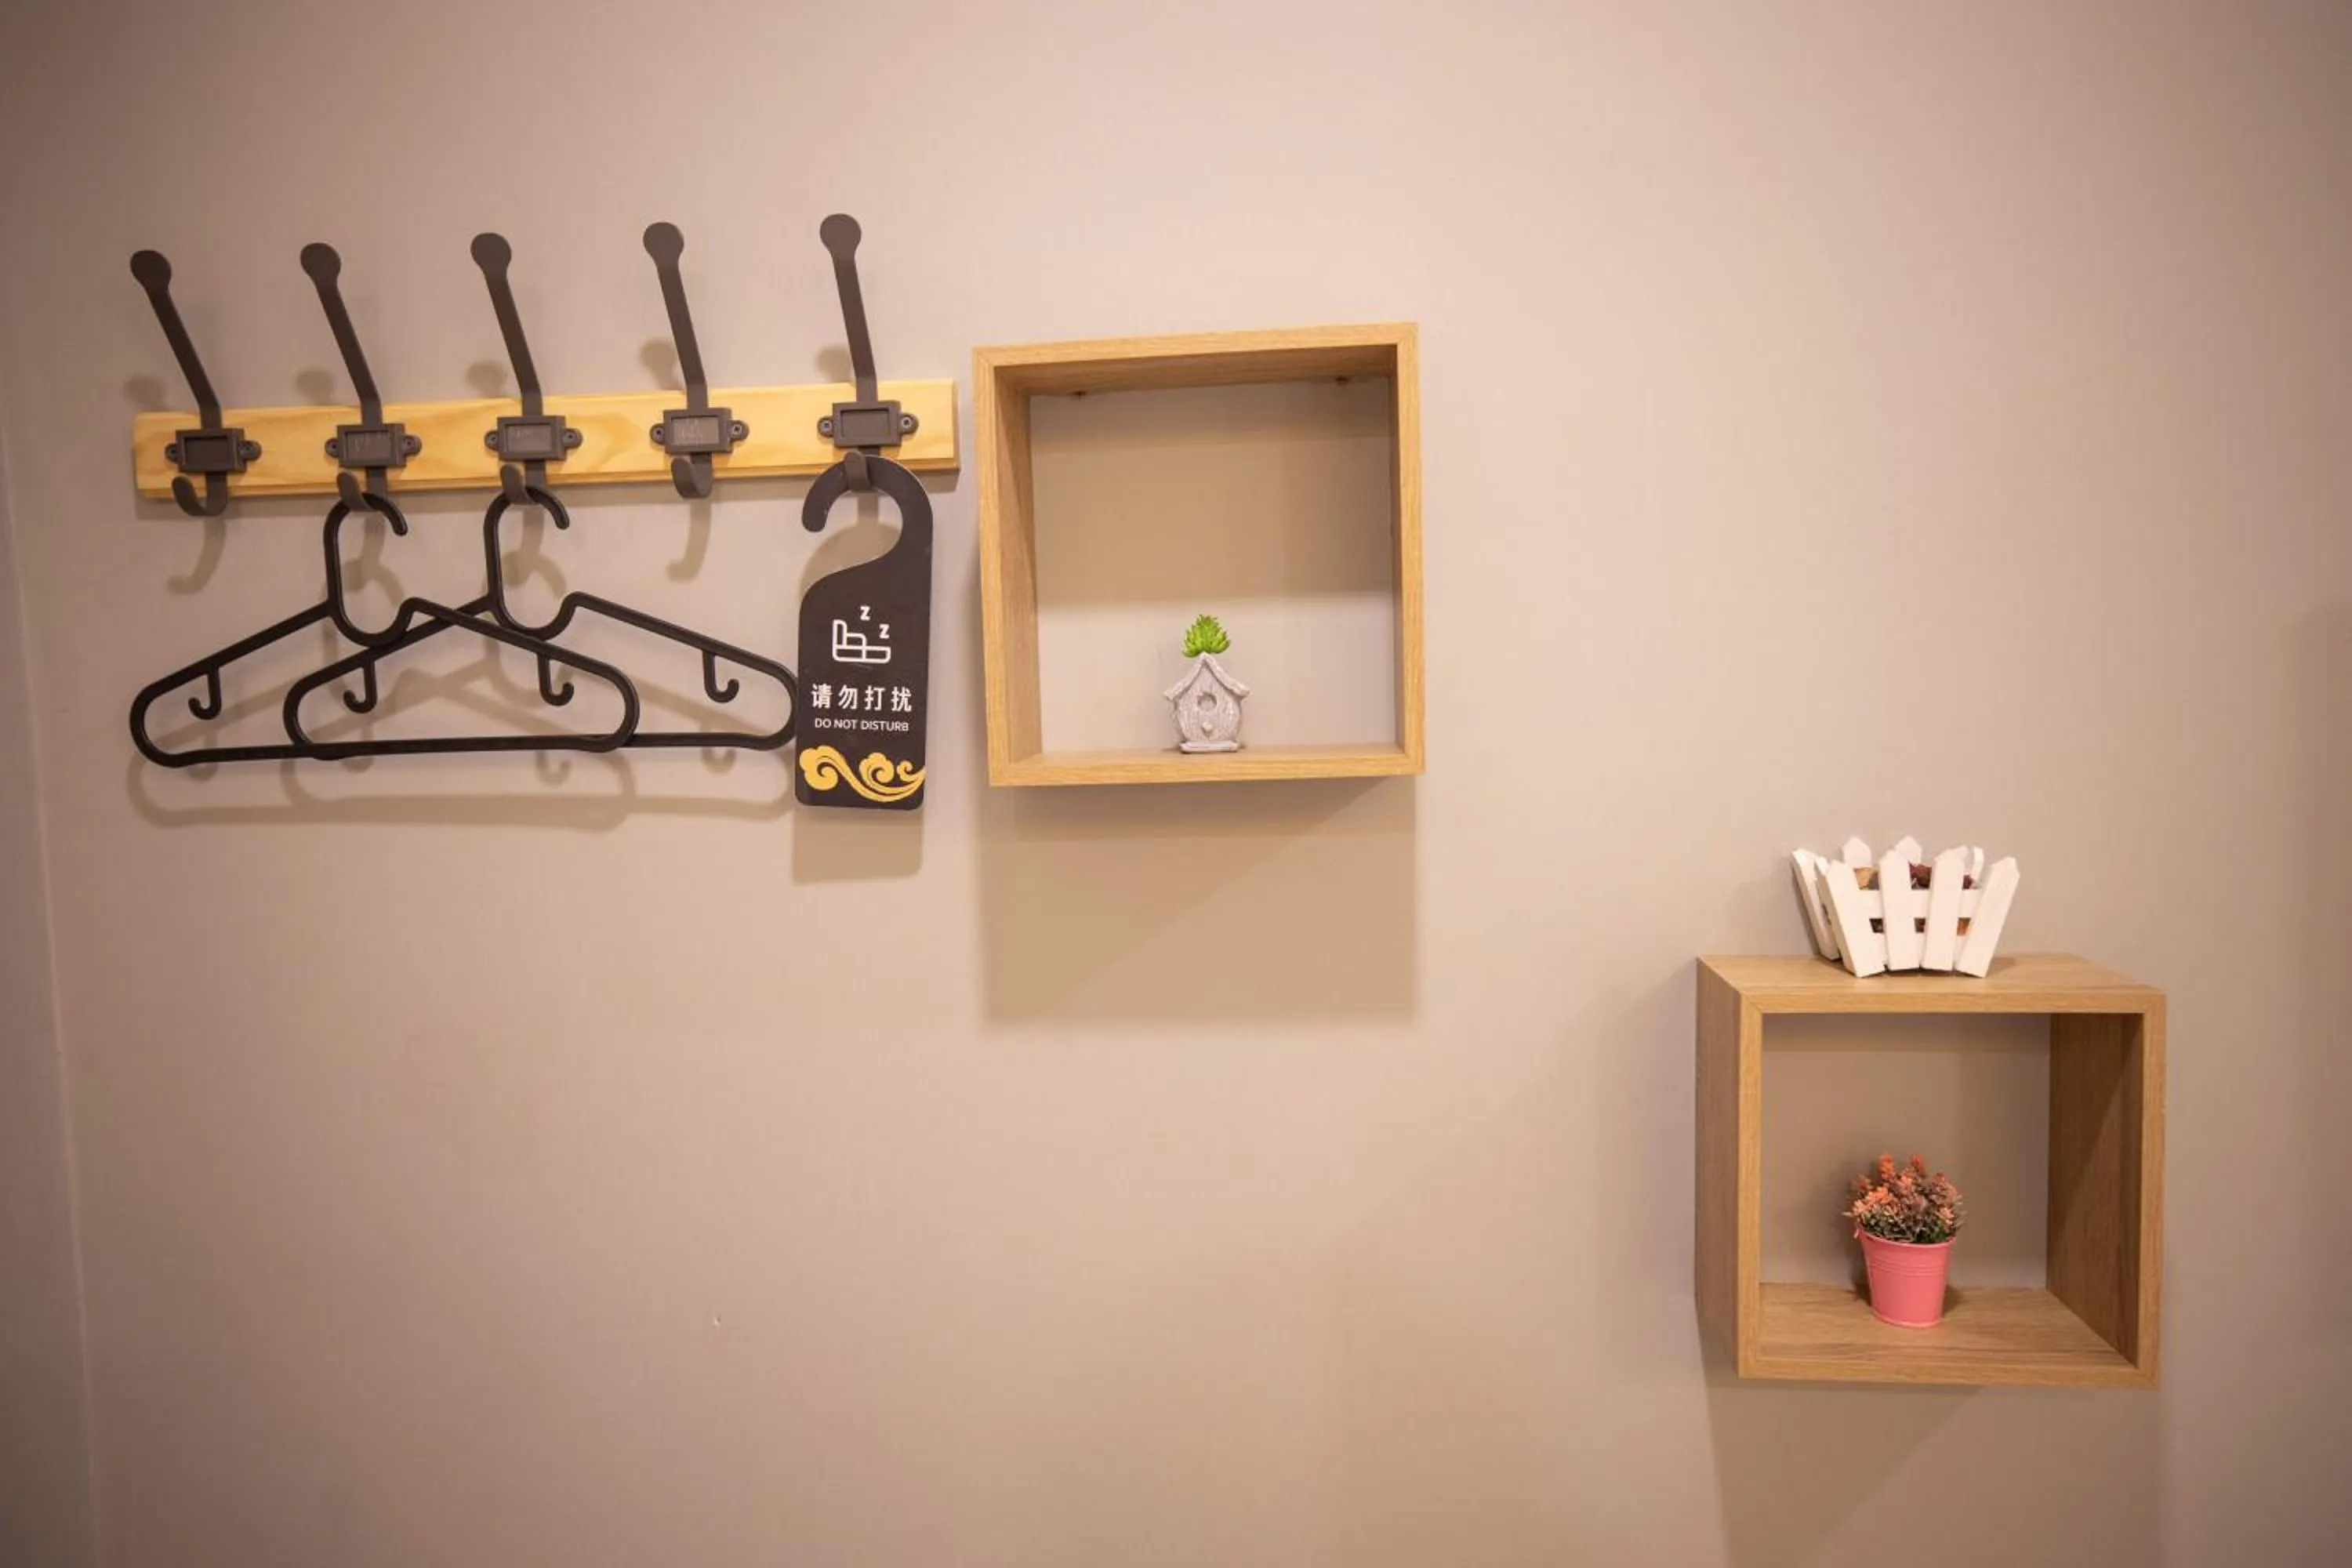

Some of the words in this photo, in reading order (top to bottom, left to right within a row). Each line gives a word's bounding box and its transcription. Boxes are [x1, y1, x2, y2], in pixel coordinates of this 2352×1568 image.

[811, 684, 912, 712] 请勿打扰
[815, 717, 831, 728] DO
[834, 719, 858, 730] NOT
[861, 720, 909, 731] DISTURB
